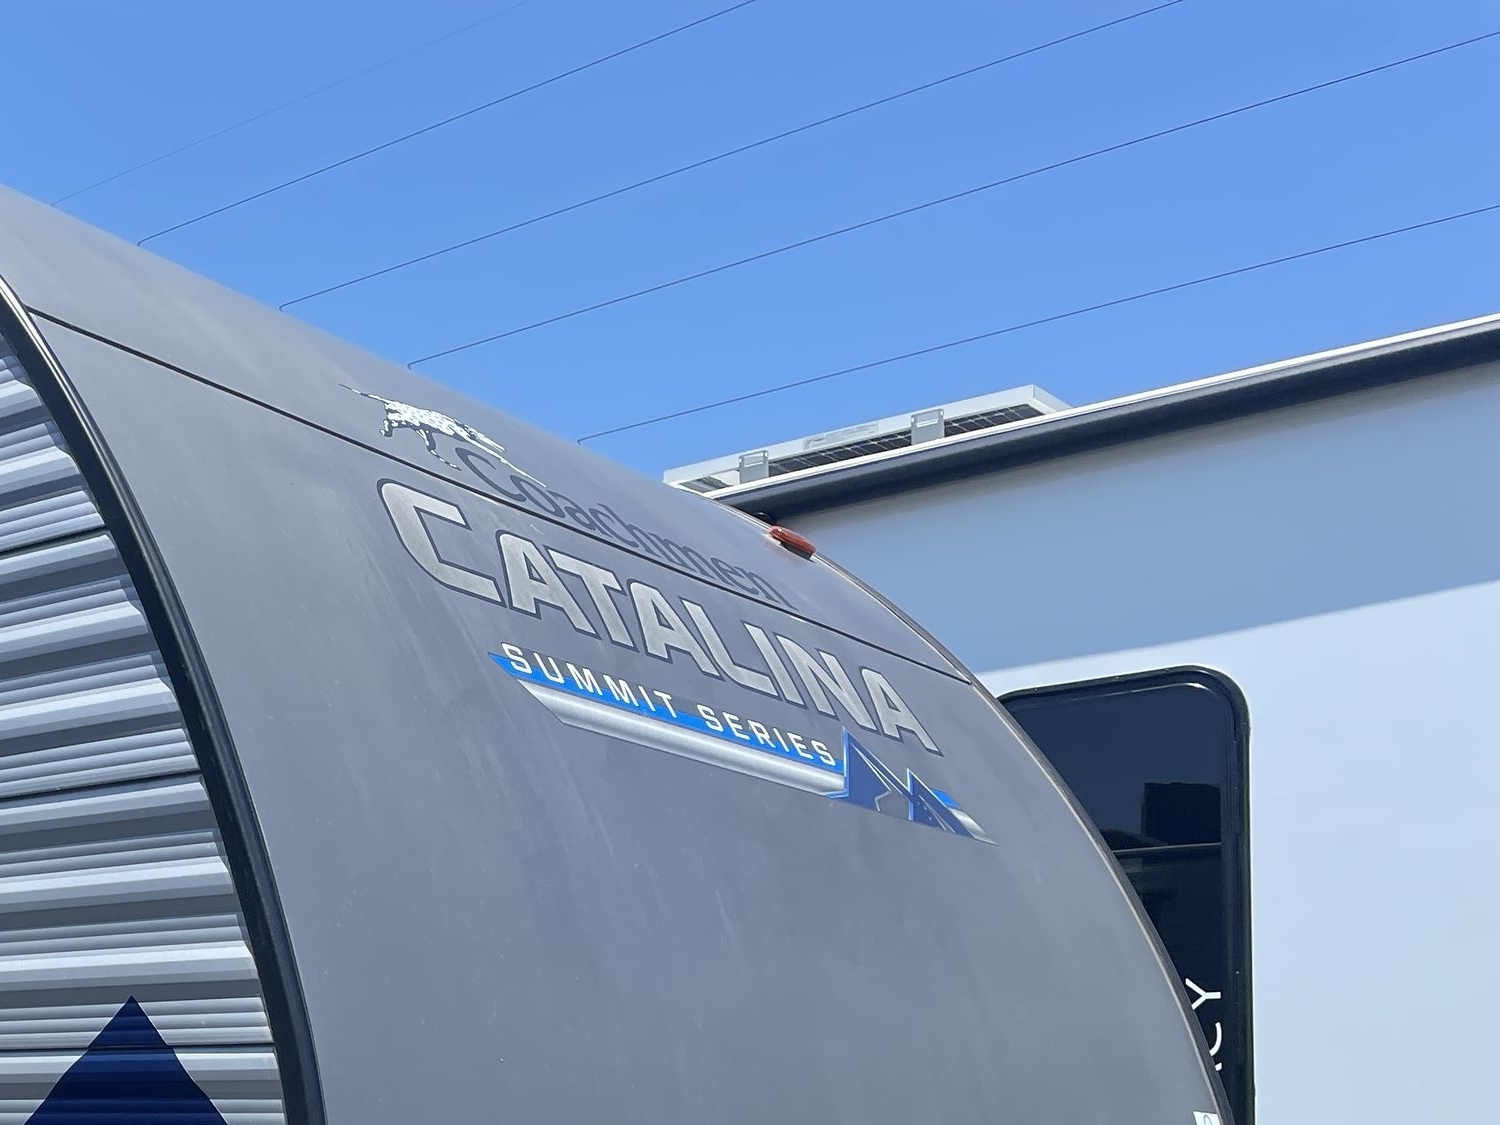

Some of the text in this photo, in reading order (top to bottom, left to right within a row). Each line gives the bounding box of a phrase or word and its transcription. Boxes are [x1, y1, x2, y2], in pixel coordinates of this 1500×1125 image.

[455, 446, 799, 609] Coachmen
[377, 478, 944, 756] CATALINA
[501, 642, 837, 766] SUMMIT SERIES
